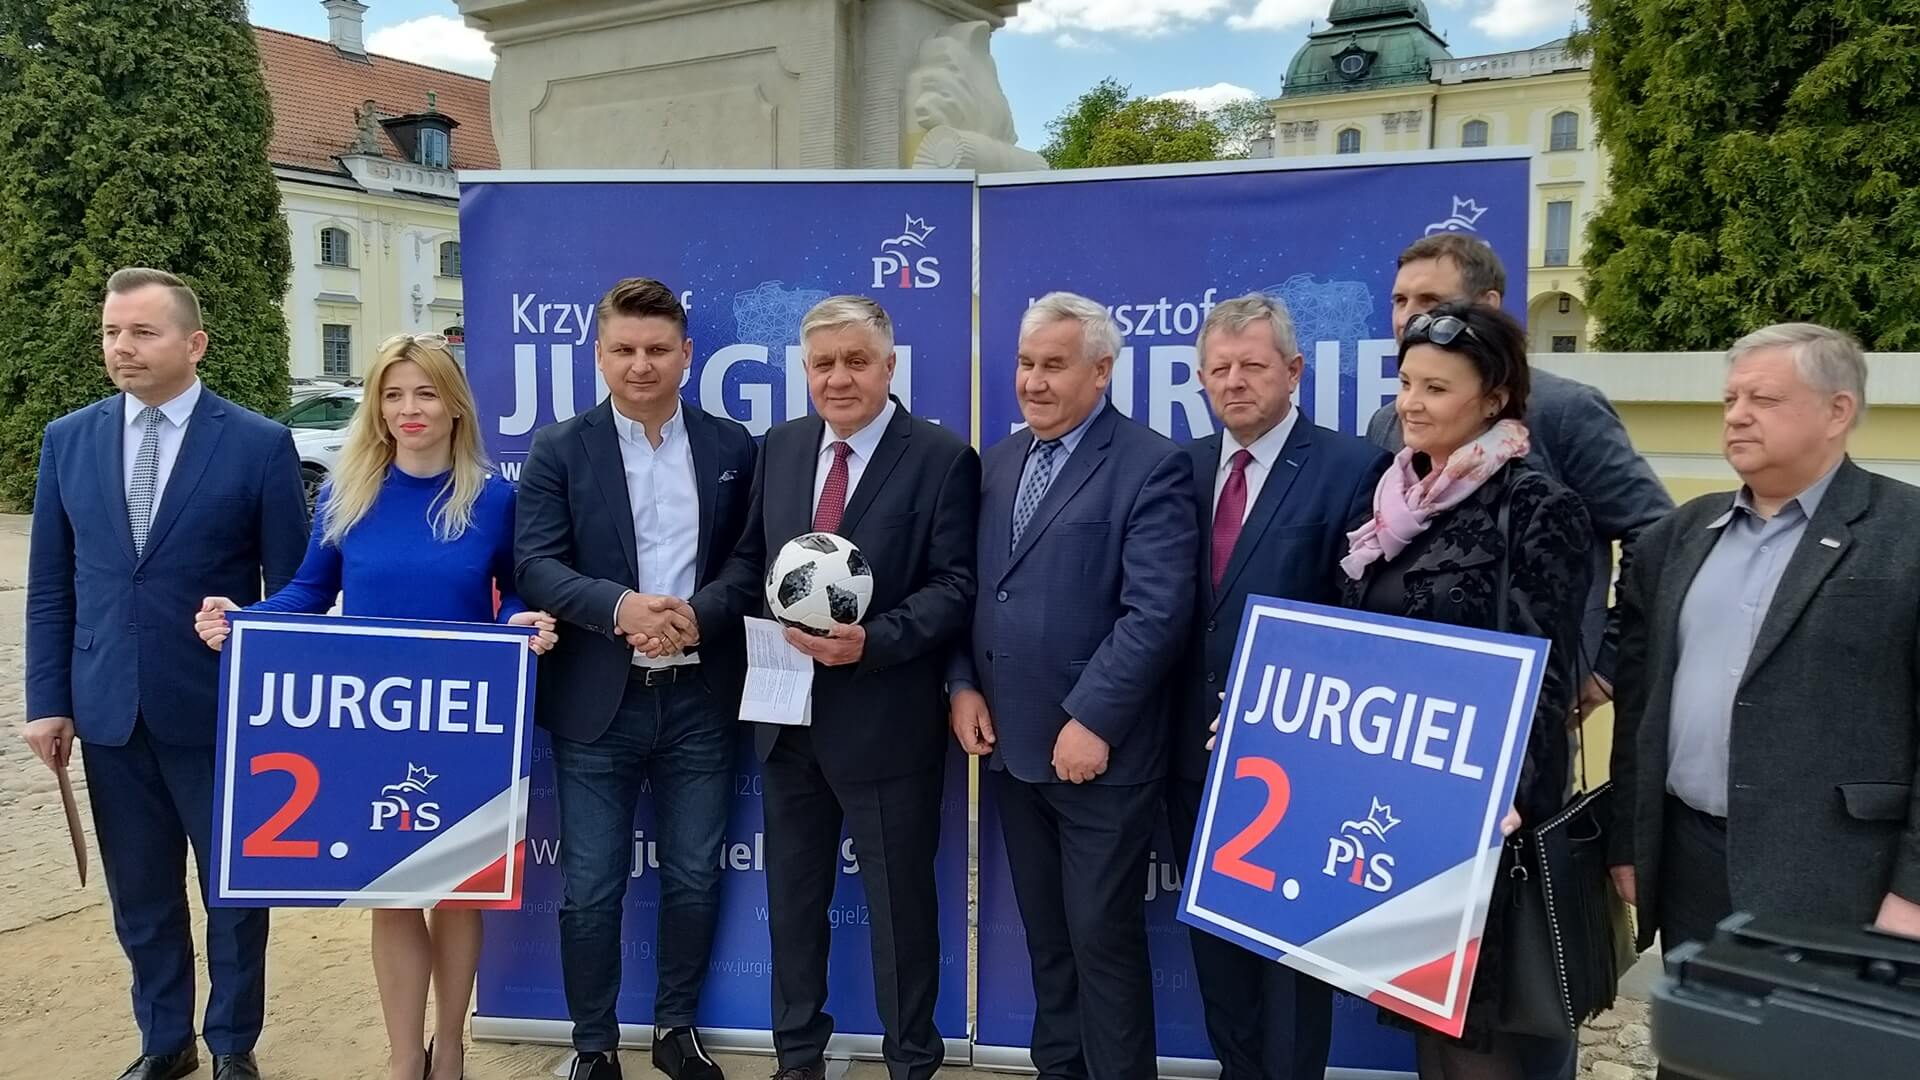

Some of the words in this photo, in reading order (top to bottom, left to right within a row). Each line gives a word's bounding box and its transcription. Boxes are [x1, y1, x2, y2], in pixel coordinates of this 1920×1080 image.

[872, 256, 941, 289] PiS
[512, 291, 693, 345] Krzyf
[249, 672, 504, 734] JURGIEL
[1243, 664, 1484, 781] JURGIEL
[242, 752, 349, 858] 2.
[369, 800, 441, 831] PiS
[1211, 756, 1301, 901] 2.
[1322, 836, 1396, 893] PiS
